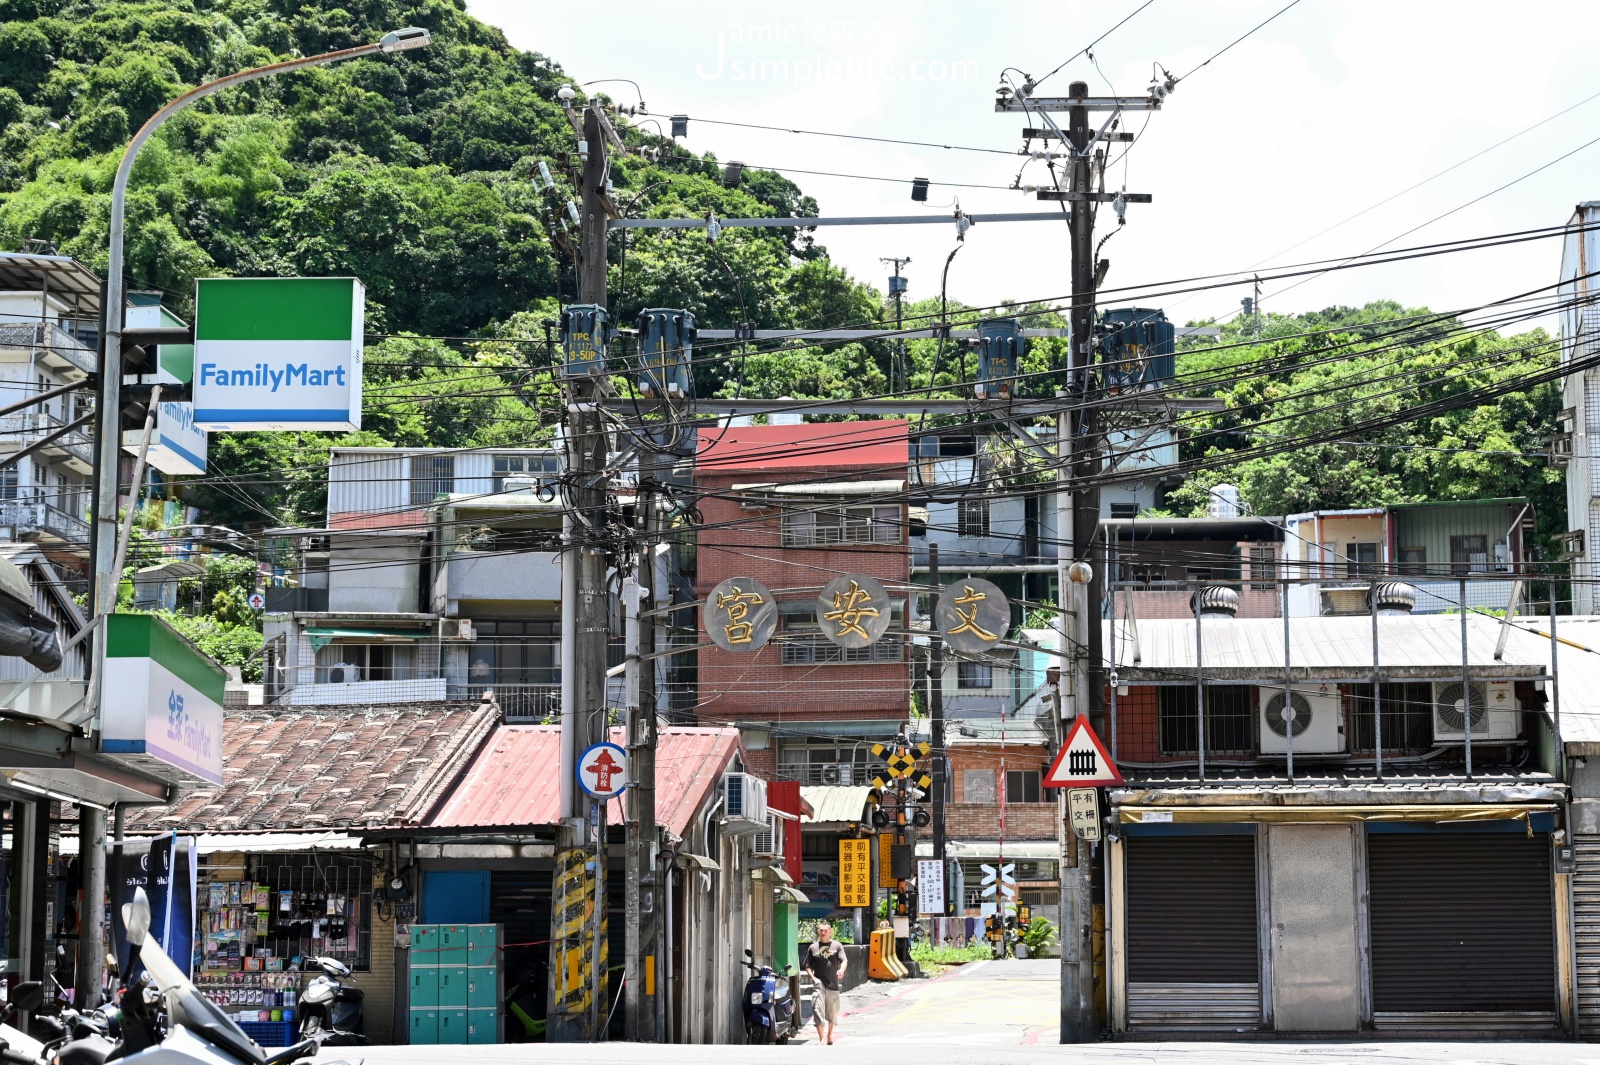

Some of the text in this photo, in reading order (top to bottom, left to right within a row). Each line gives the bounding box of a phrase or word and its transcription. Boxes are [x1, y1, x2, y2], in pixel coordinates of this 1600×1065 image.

[200, 363, 346, 392] FamilyMart
[167, 688, 211, 761] 全家 FamilyMart
[600, 765, 608, 787] 消防栓
[1072, 793, 1085, 837] 平交道
[1084, 793, 1096, 836] 有柵門
[843, 841, 853, 904] 視器錄影舉發
[856, 841, 866, 904] 前有平交道監
